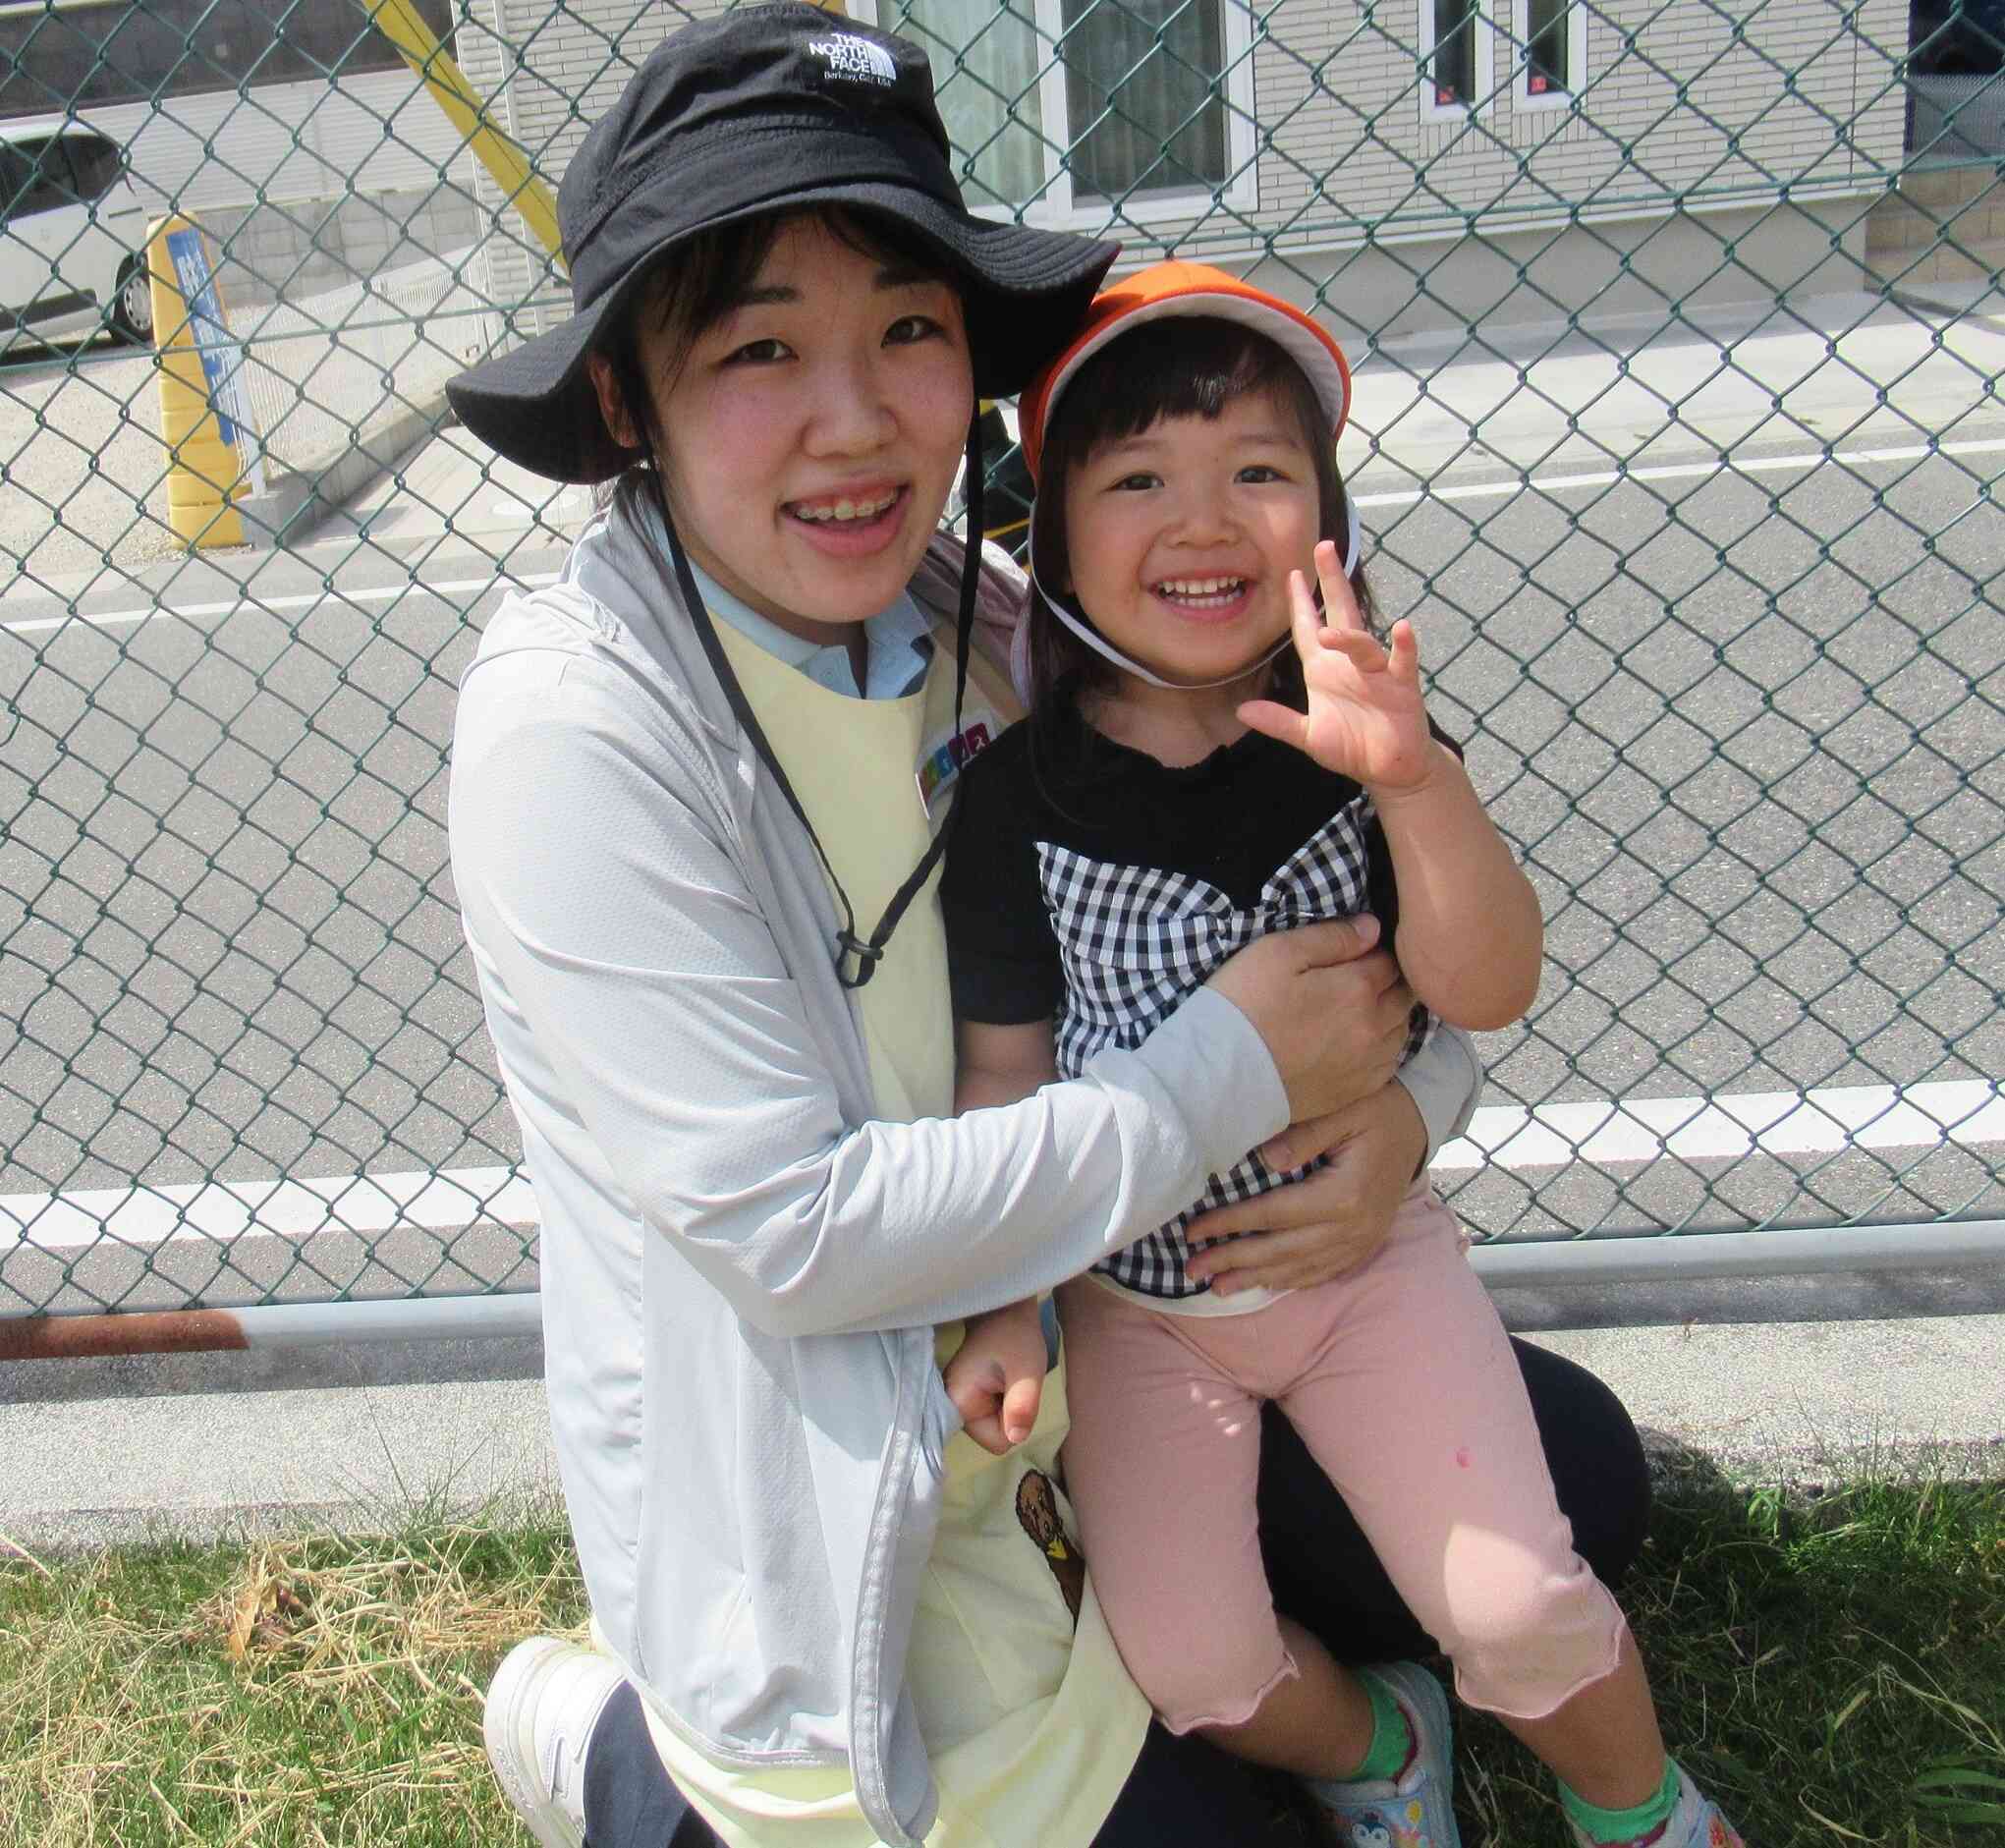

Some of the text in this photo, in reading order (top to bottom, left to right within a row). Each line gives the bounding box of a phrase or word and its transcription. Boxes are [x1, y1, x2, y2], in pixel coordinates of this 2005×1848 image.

[831, 33, 864, 46] THE
[808, 42, 868, 59] NORTH
[830, 56, 870, 73] FACE
